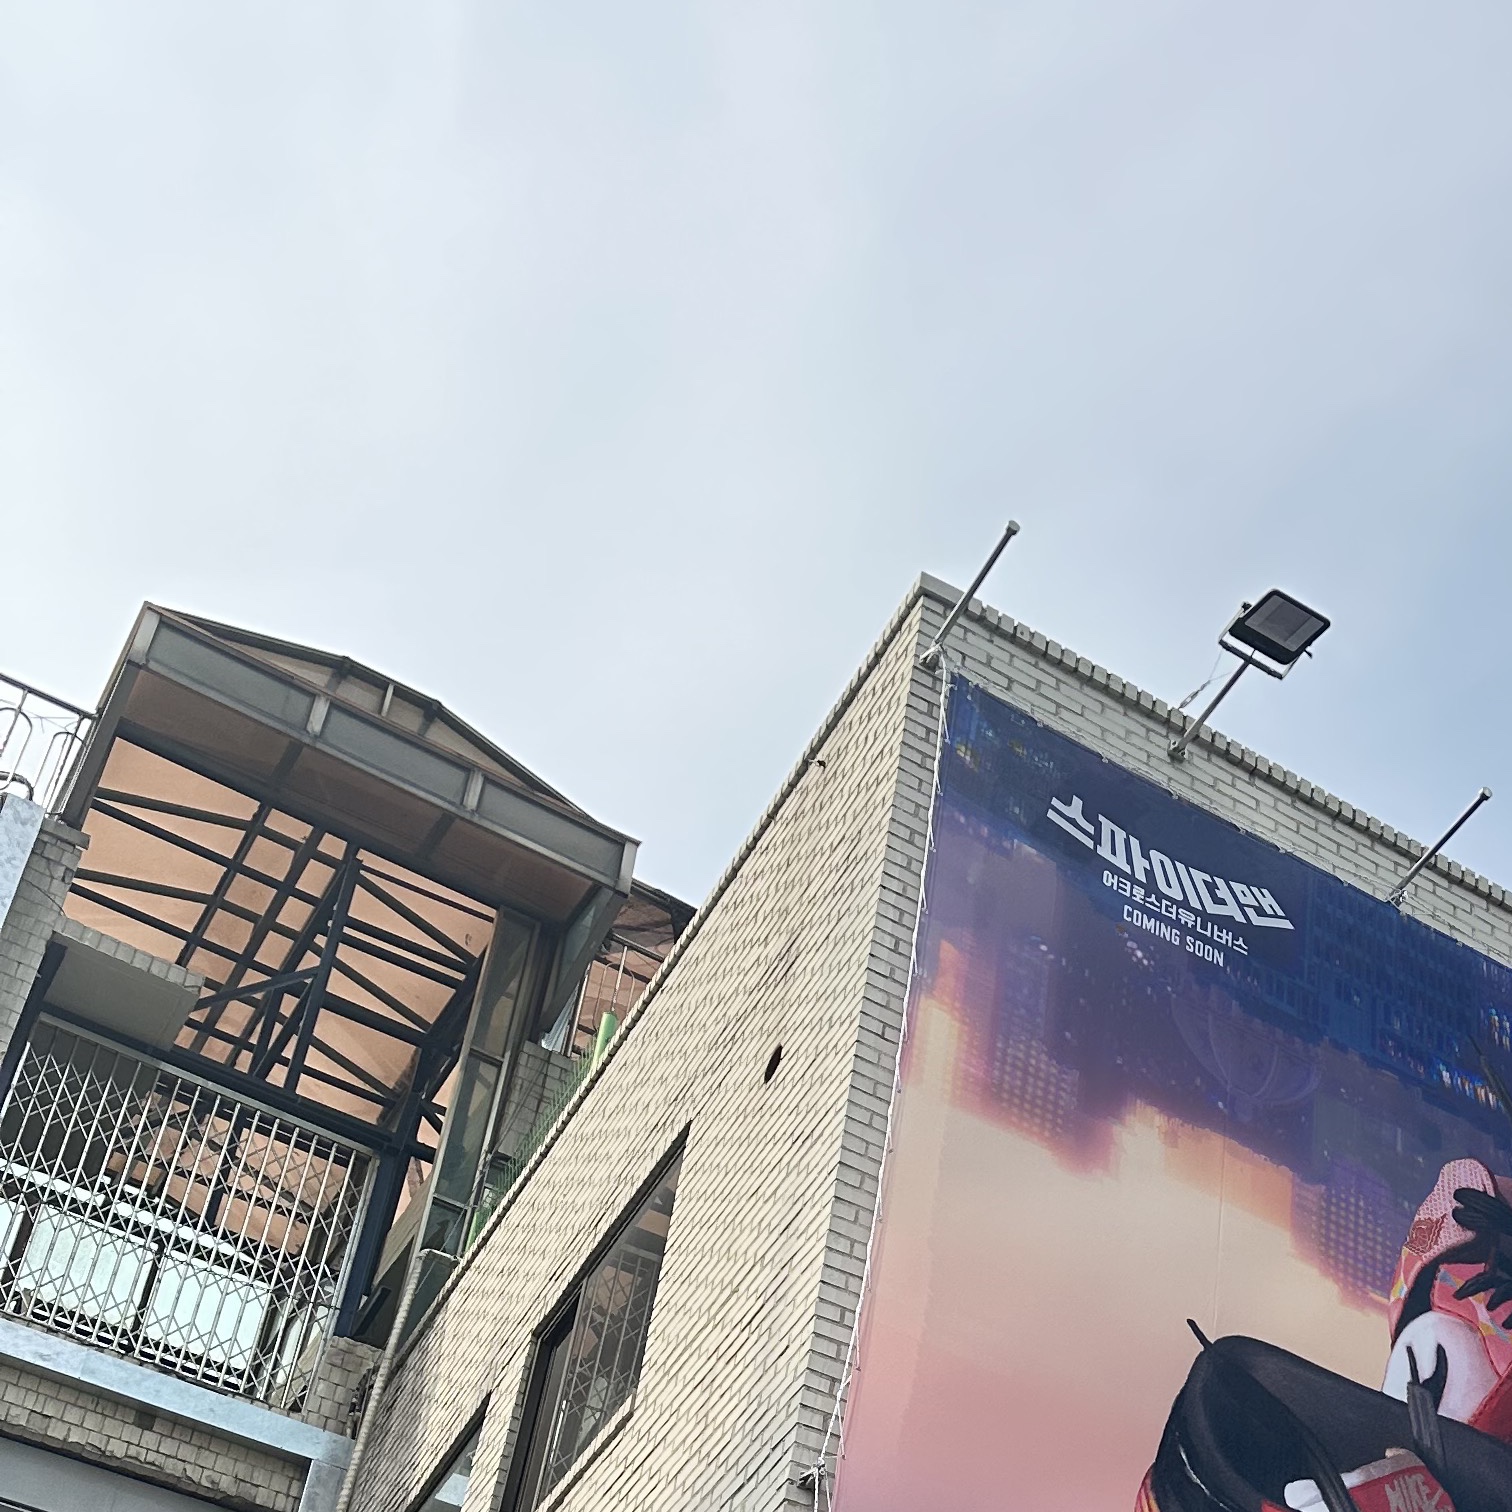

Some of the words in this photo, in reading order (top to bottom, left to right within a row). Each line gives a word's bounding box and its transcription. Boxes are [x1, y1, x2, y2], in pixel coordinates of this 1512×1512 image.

[1047, 795, 1295, 930] 스파이더맨
[1123, 904, 1180, 946] COMING
[1185, 935, 1224, 967] SOON
